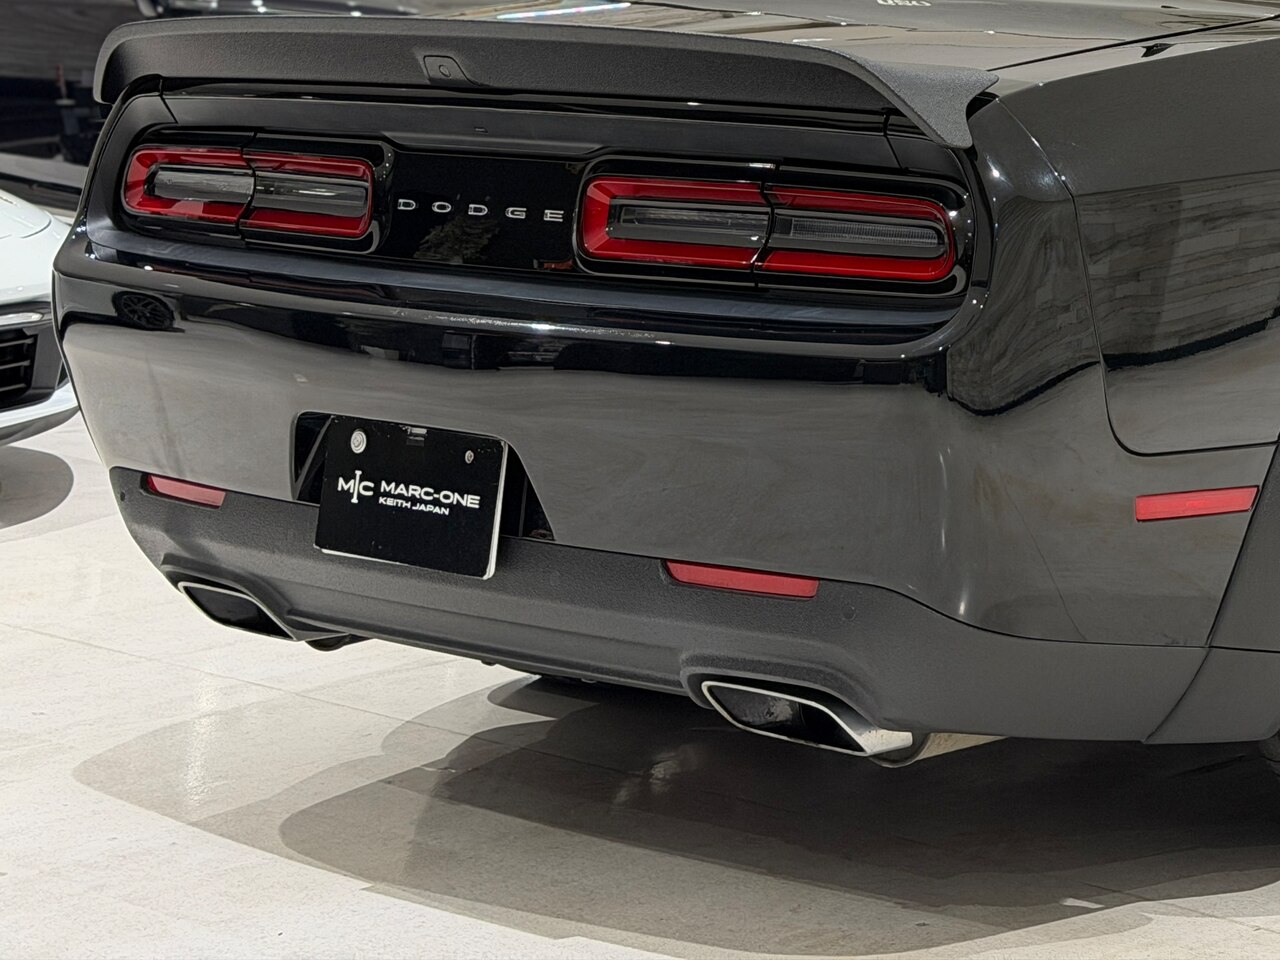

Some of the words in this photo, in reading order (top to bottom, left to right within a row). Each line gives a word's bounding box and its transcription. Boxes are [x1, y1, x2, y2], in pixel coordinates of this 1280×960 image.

[397, 198, 565, 222] DODGE
[378, 496, 411, 509] KEITH
[412, 502, 450, 516] JAPAN
[380, 480, 481, 509] MARC-ONE
